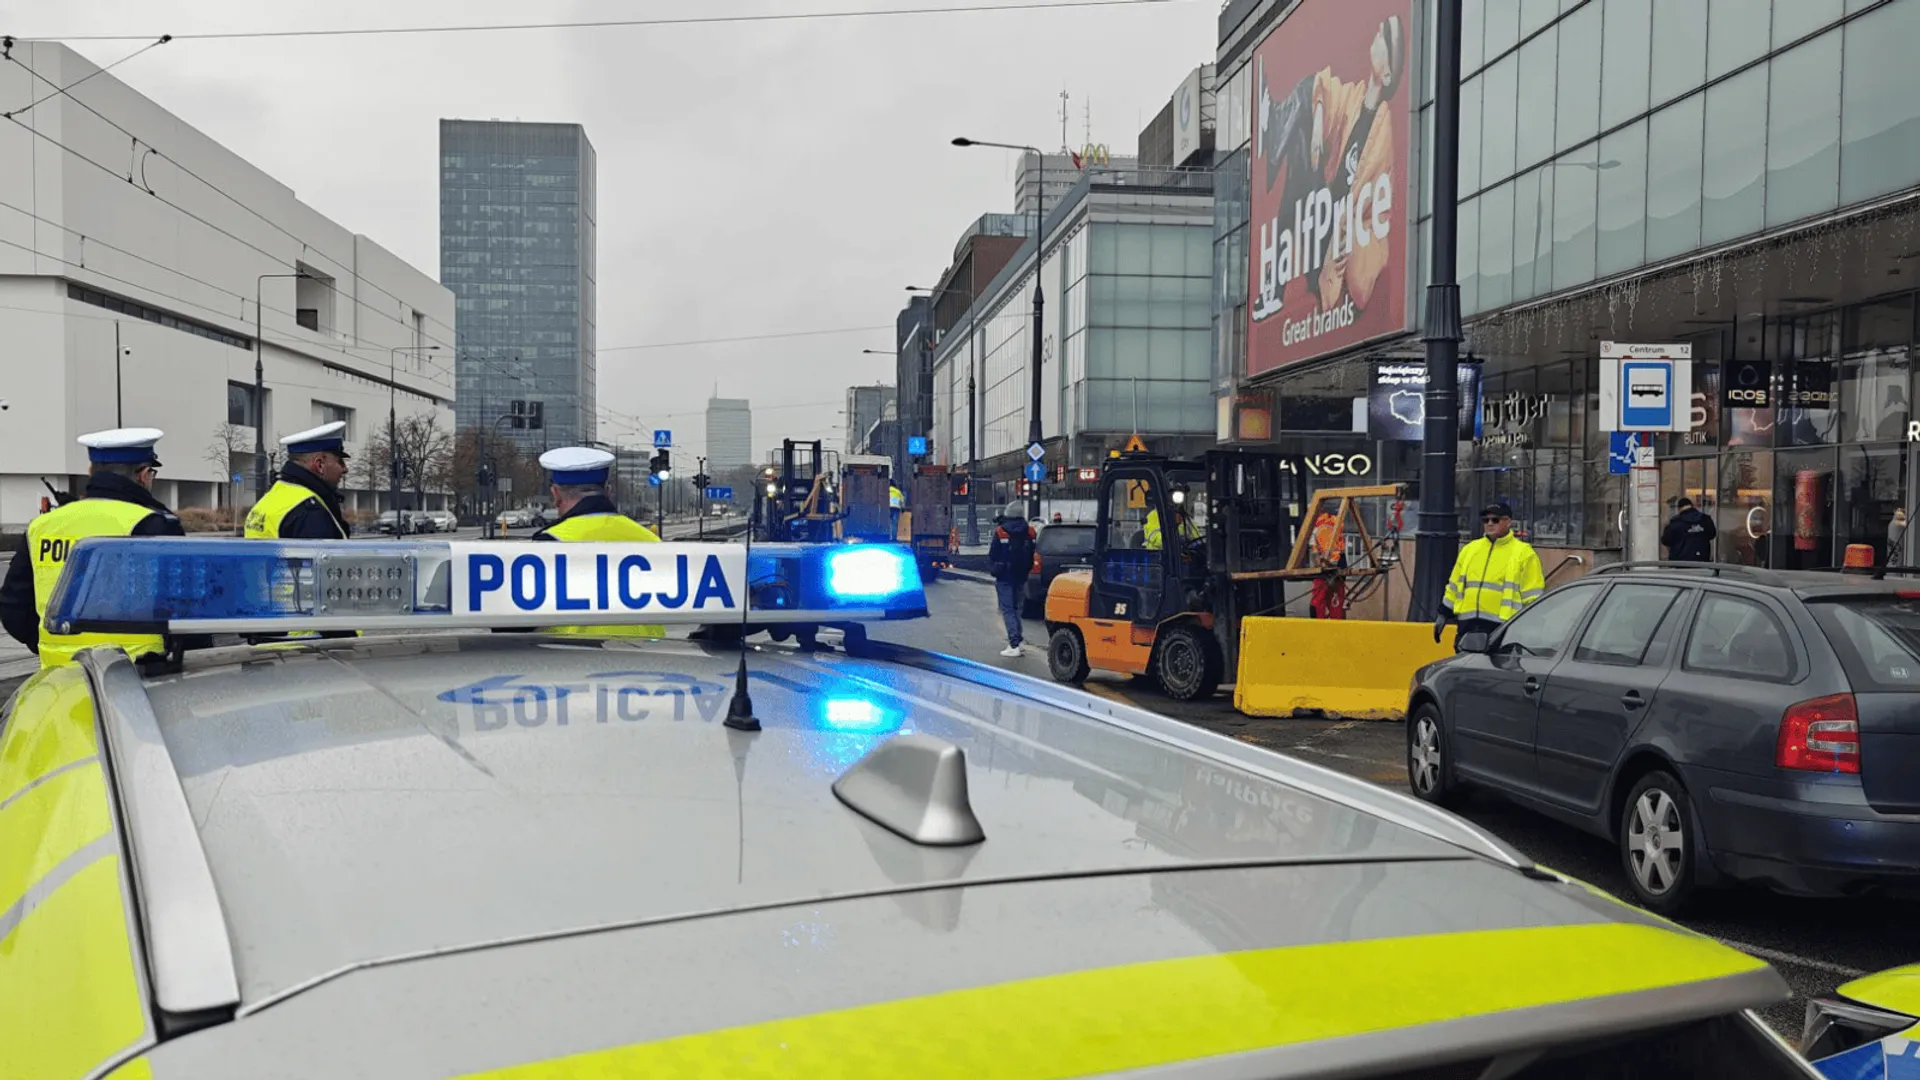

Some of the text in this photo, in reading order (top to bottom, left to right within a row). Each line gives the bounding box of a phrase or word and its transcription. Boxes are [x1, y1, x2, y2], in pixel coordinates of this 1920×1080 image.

[1259, 172, 1392, 299] HalfPrice
[1282, 294, 1354, 347] Great brands
[1628, 345, 1690, 354] Centrum 12
[1728, 389, 1766, 401] IQOS
[1683, 431, 1707, 445] BUTIK
[468, 553, 736, 612] POLICJA
